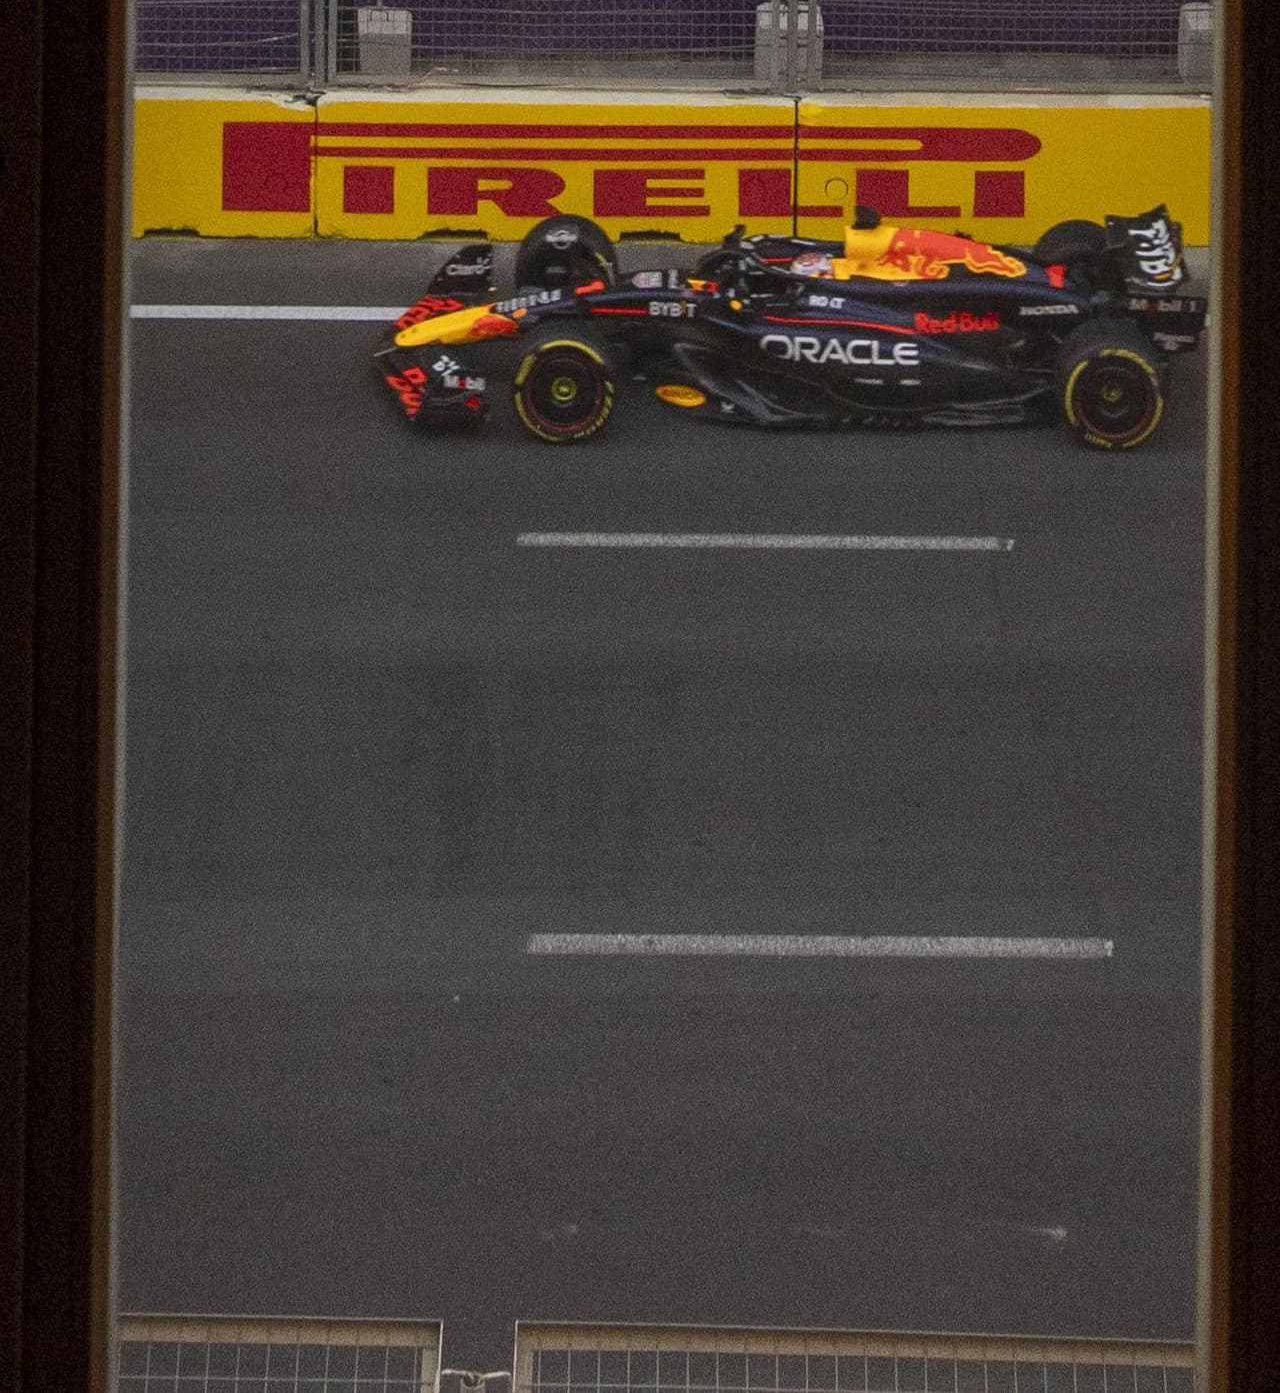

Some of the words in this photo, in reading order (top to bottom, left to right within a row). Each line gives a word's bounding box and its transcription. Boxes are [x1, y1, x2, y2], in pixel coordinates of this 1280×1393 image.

[222, 121, 1042, 219] PIRELLI
[914, 311, 957, 334] Red
[959, 310, 1000, 332] Bull
[760, 334, 921, 366] ORACLE
